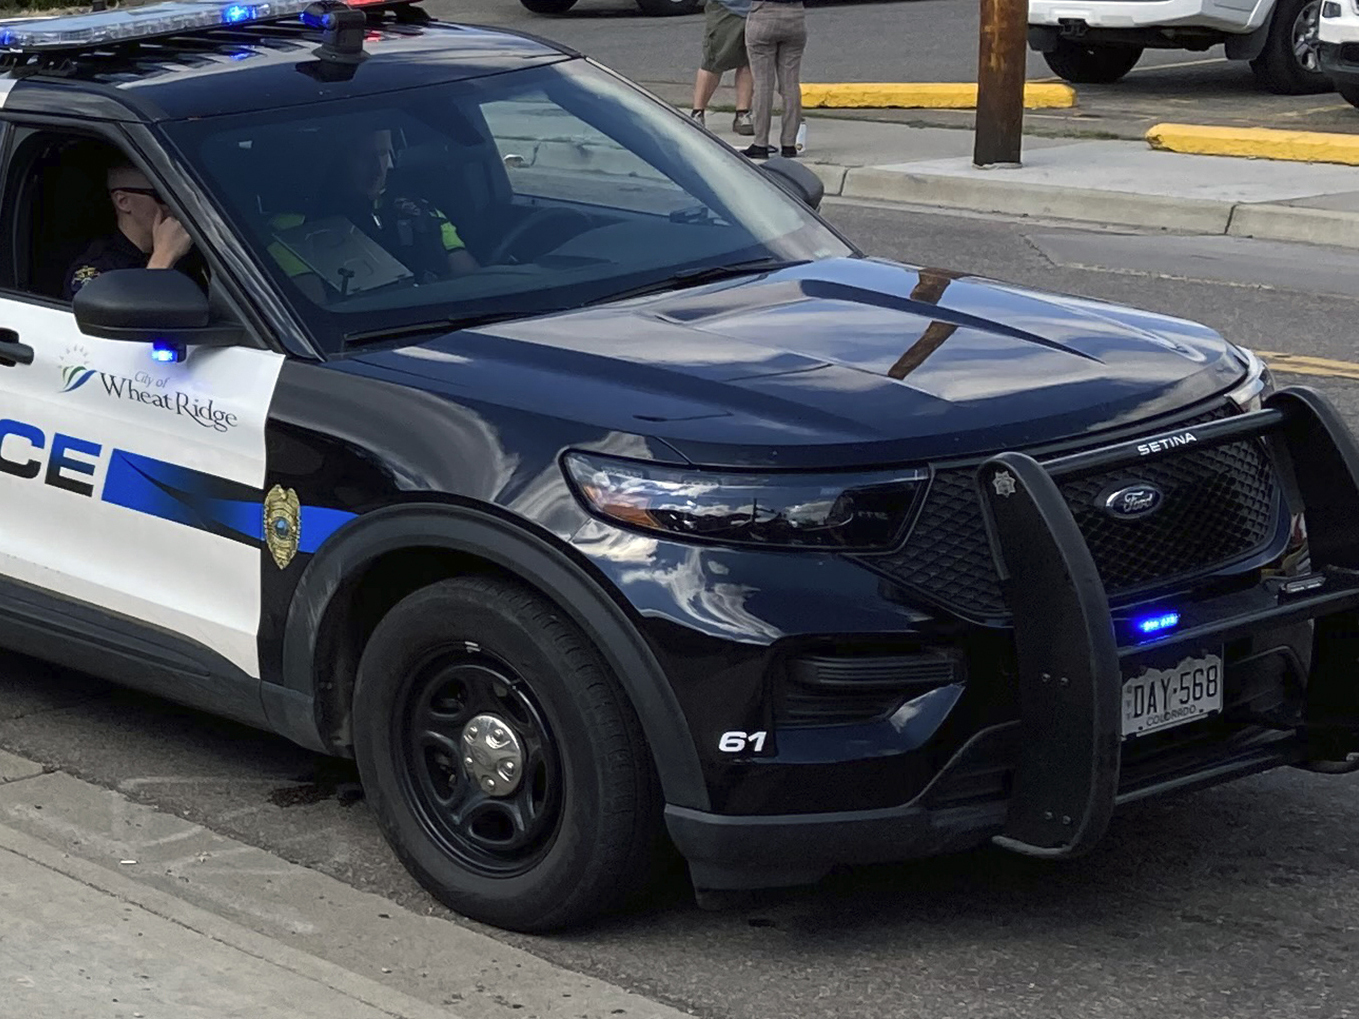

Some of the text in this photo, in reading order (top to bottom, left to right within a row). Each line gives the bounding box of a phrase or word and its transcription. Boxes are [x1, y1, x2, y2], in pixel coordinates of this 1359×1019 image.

[134, 370, 171, 389] City of
[99, 372, 238, 432] Wheat Ridge
[1137, 432, 1197, 456] SETINA
[1123, 490, 1153, 513] Ford
[1146, 704, 1197, 727] COLORADO
[718, 731, 767, 752] 61
